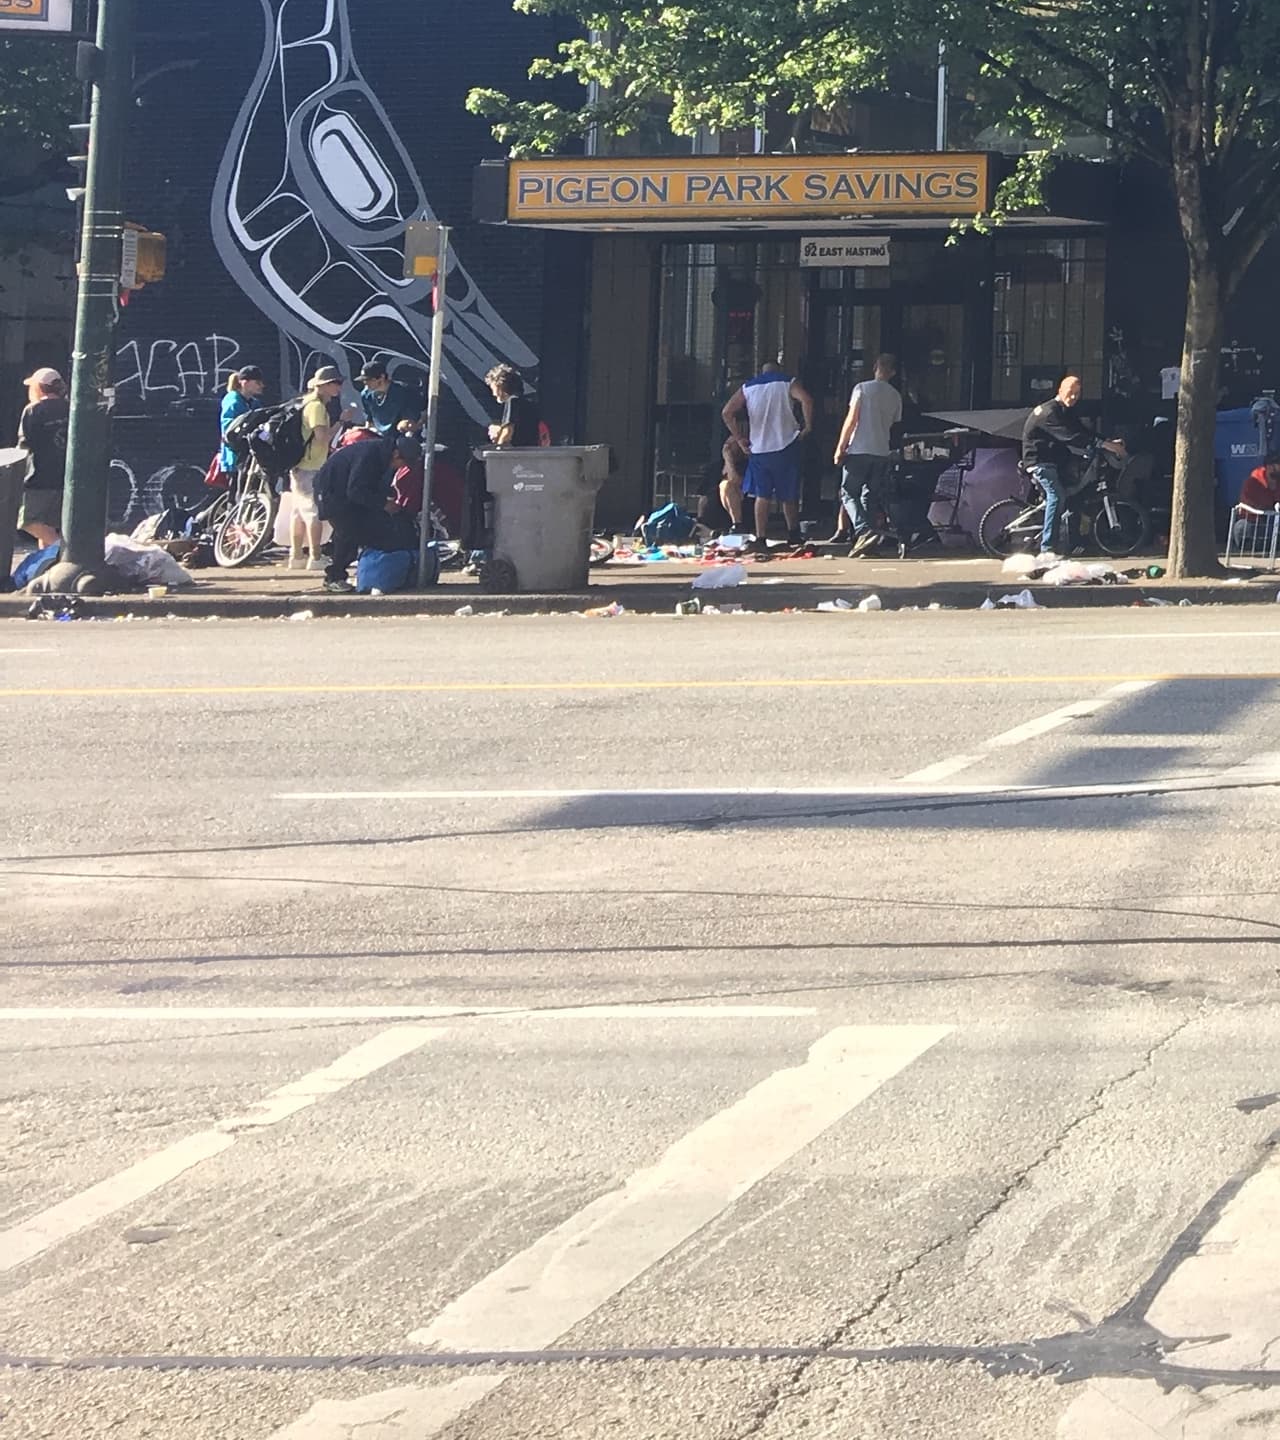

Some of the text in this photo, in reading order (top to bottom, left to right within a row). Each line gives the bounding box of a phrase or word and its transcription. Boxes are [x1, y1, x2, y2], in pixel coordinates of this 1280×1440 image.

[518, 172, 978, 204] PIGEON PARK SAVINGS
[820, 247, 843, 257] EAST
[115, 333, 241, 400] ACAB
